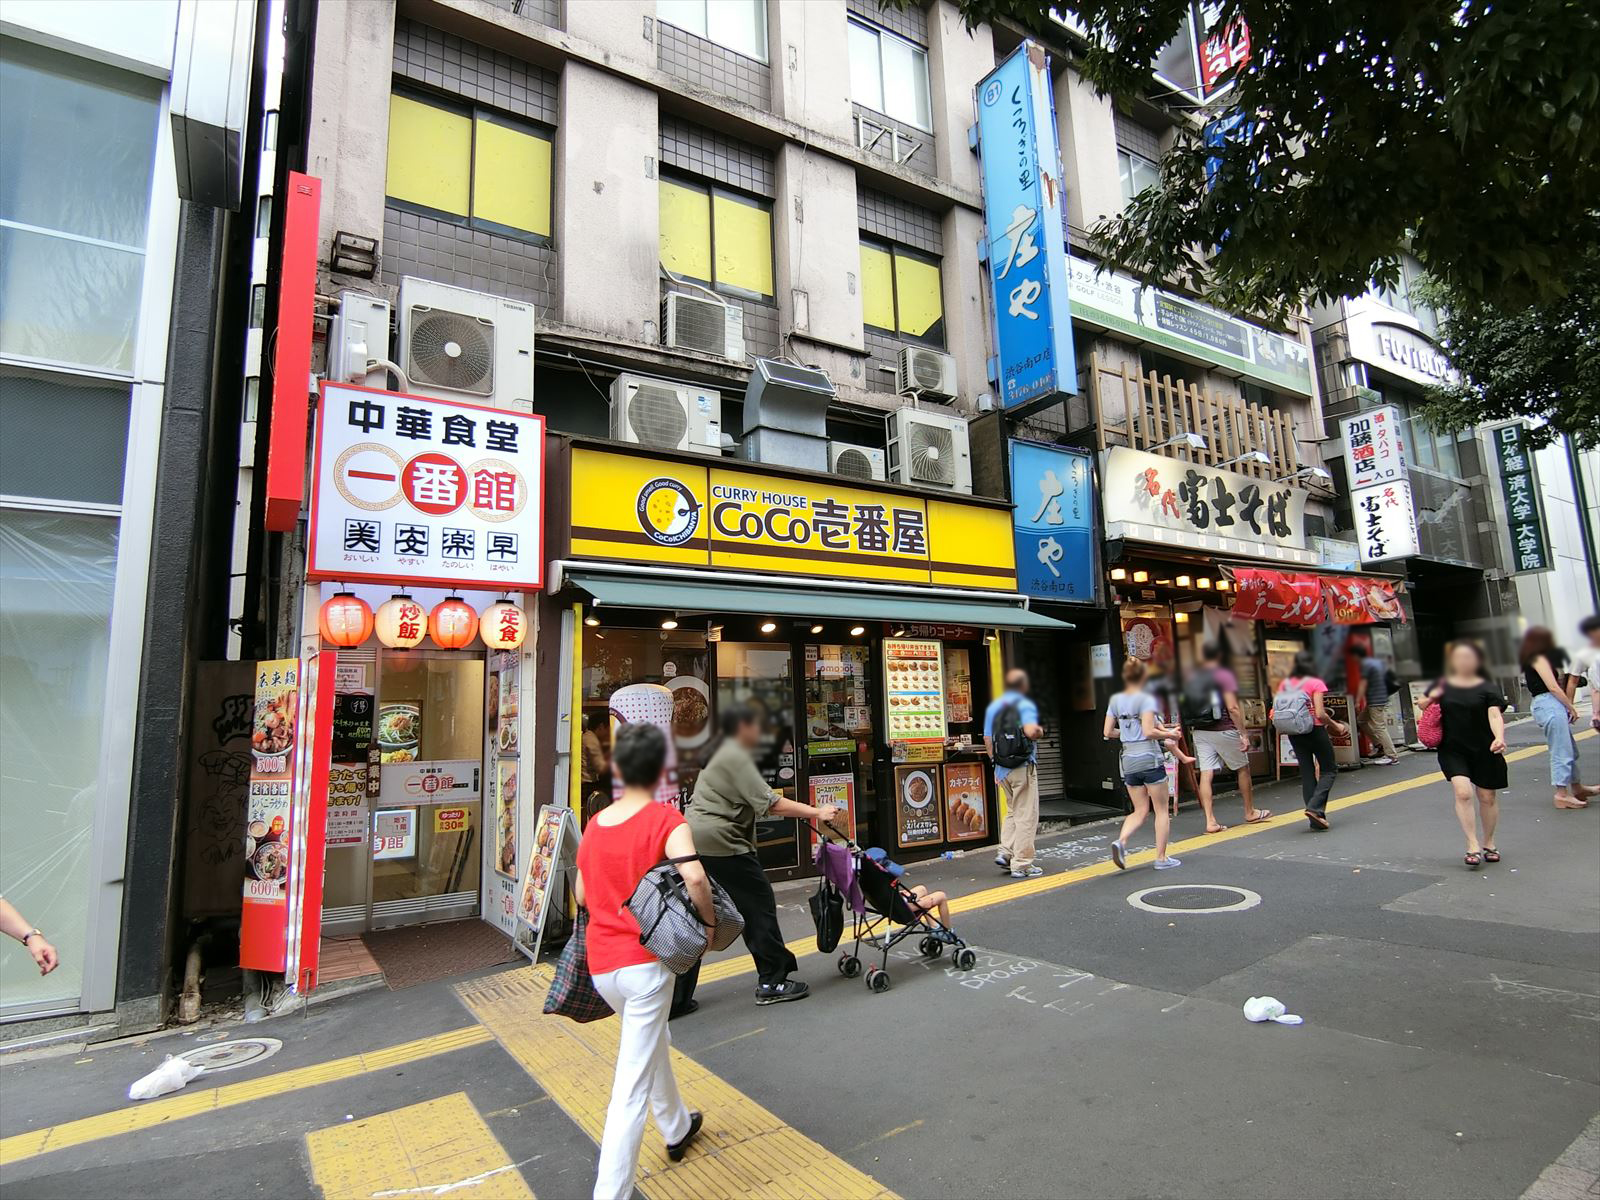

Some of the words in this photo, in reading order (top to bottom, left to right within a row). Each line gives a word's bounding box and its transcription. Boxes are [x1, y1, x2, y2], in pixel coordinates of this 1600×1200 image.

[1011, 85, 1035, 191] くつろぎの里
[997, 204, 1042, 320] 庄や
[503, 303, 526, 312] TOSHIBA
[348, 400, 519, 453] 中華食堂
[1374, 412, 1389, 458] 酒・タバコ
[1349, 419, 1376, 474] 加藤酒店
[348, 460, 516, 512] 一番館
[1374, 468, 1394, 481] 入口
[712, 485, 757, 503] CURRY
[761, 492, 807, 509] HOUSE
[1144, 467, 1180, 519] 名代
[1179, 469, 1292, 538] 富士そば
[1382, 487, 1399, 508] 名代
[348, 521, 379, 552] 美
[398, 526, 428, 553] 安
[443, 531, 474, 558] 楽
[489, 534, 517, 559] 早
[1031, 470, 1064, 577] 庄や
[1360, 495, 1390, 558] 富士そば
[343, 553, 379, 563] おいしい
[397, 557, 425, 566] やすい
[442, 560, 475, 569] たのしい
[489, 564, 514, 572] はやい
[1031, 579, 1075, 594] 渋谷南口店
[397, 604, 420, 640] 炒飯
[499, 608, 519, 643] 定食
[891, 623, 973, 639] ち帰りコーナー
[257, 755, 286, 773] 500円
[368, 749, 381, 794] 営業中
[949, 776, 980, 788] カキフライ
[408, 776, 454, 791] 一番館
